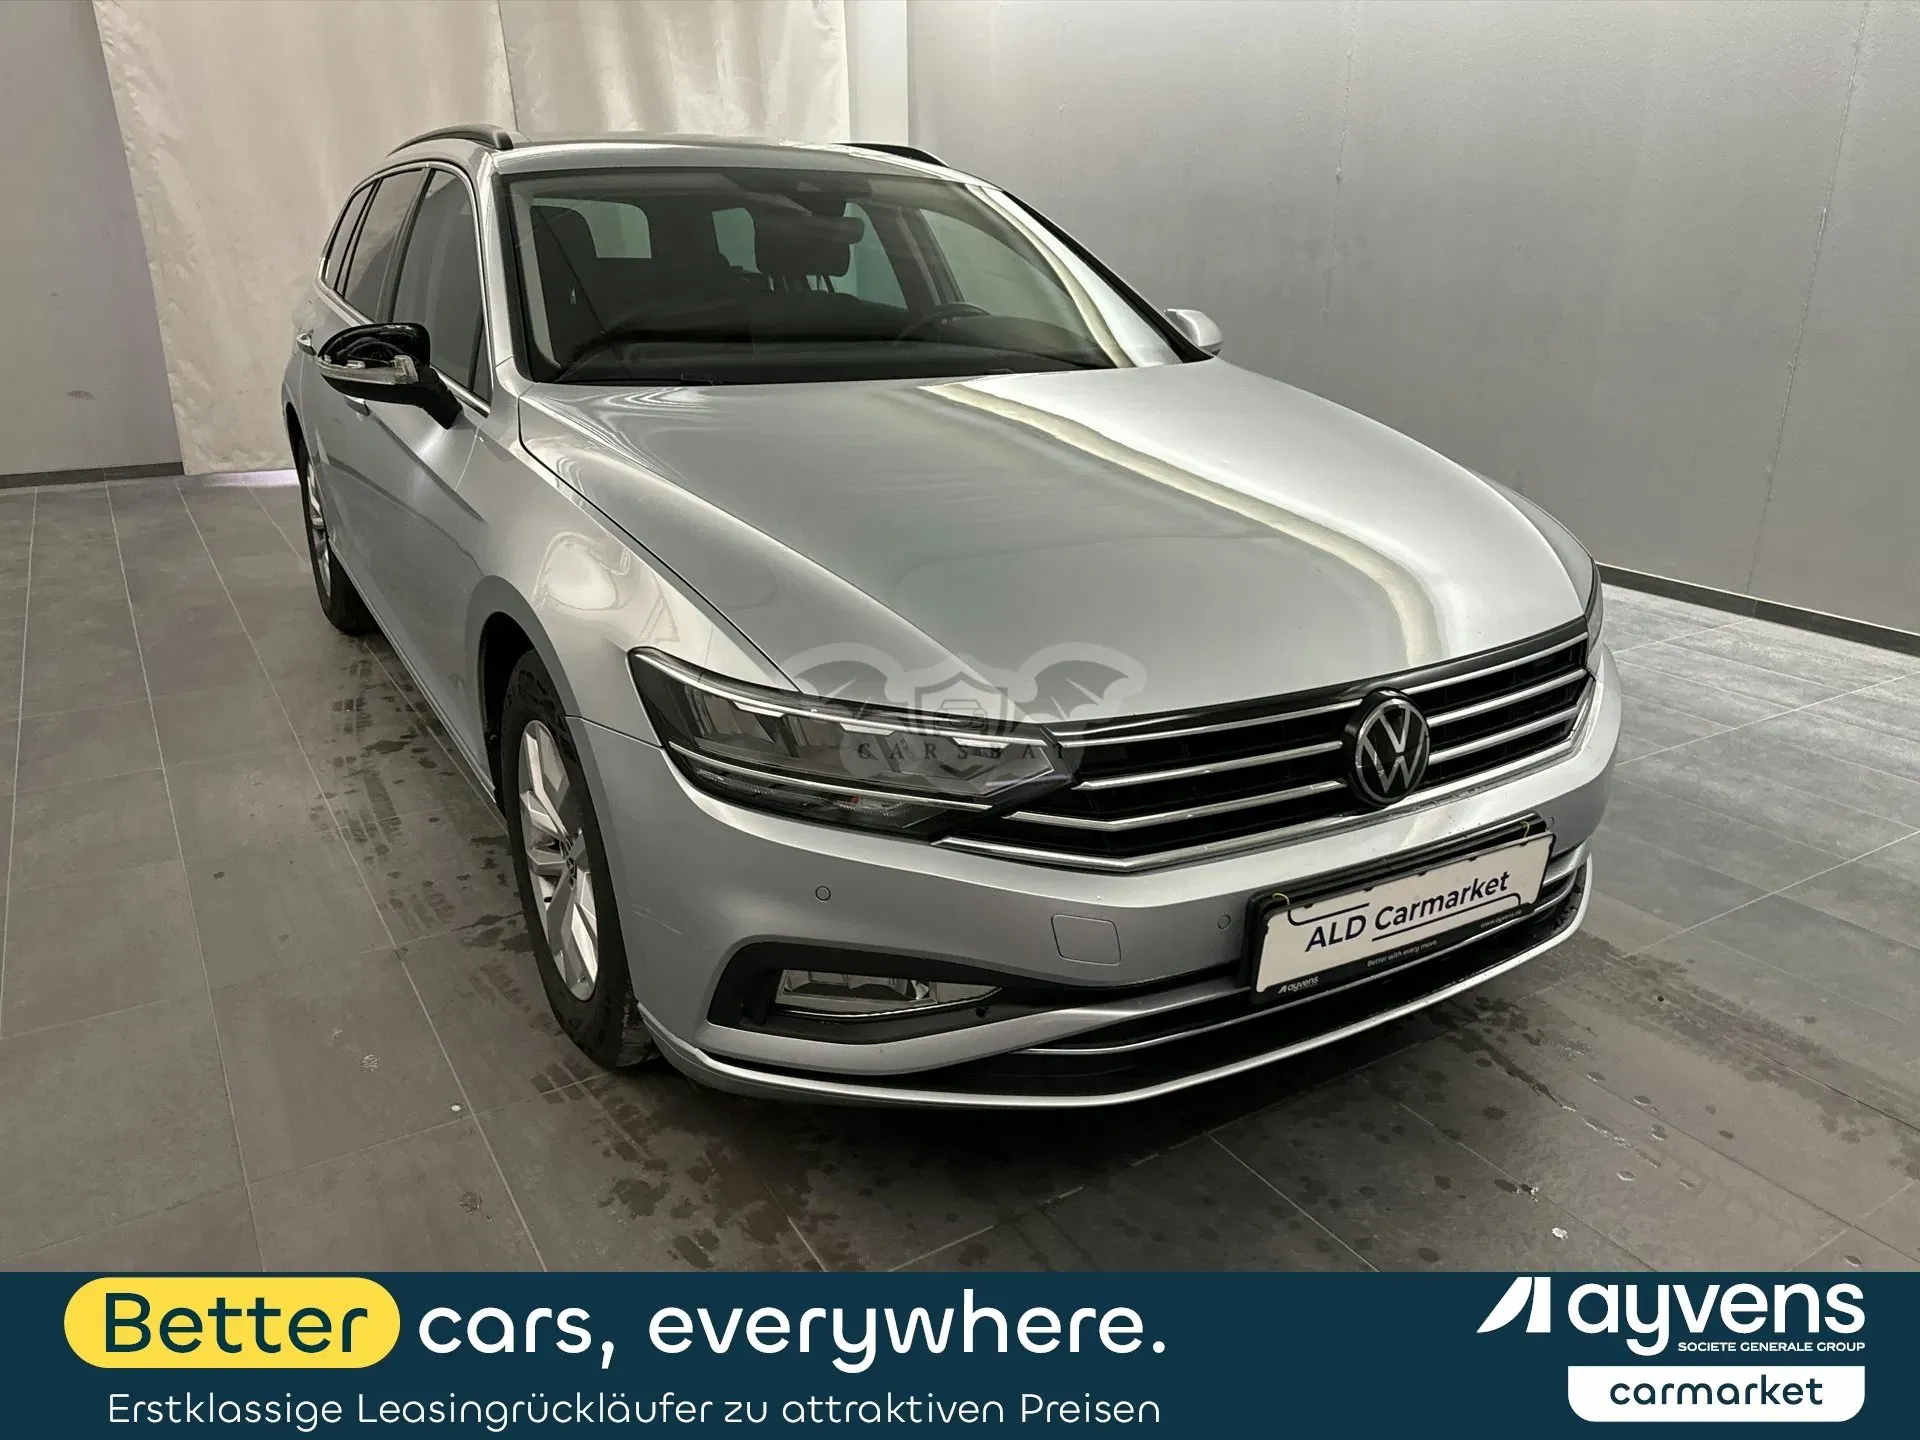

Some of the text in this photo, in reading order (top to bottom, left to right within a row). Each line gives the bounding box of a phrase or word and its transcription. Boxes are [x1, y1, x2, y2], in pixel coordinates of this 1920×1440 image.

[1304, 871, 1509, 952] ALD Carmarket
[1287, 976, 1319, 992] ayvens
